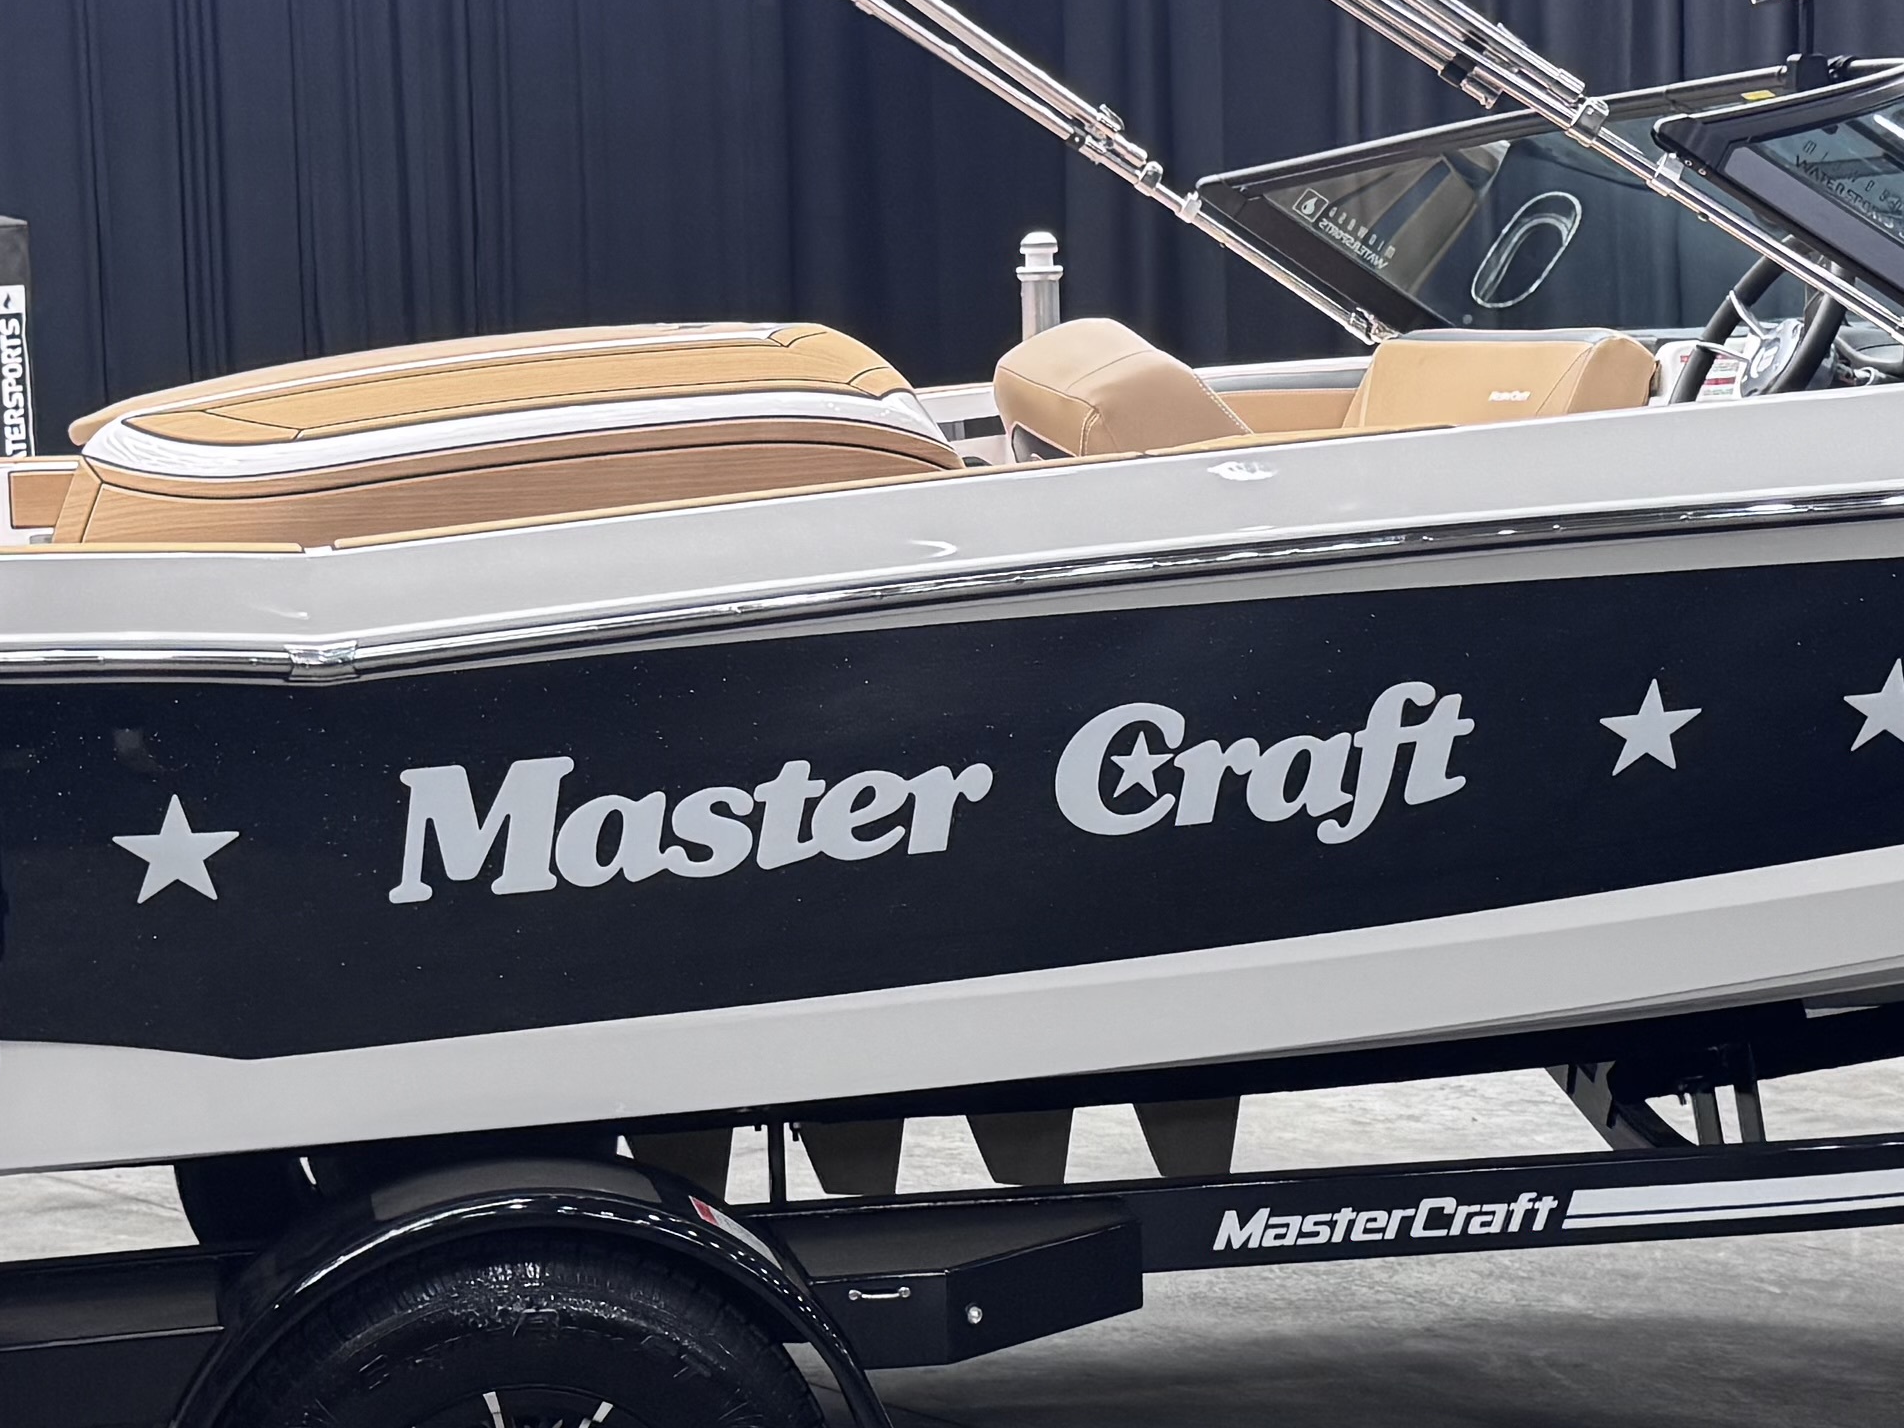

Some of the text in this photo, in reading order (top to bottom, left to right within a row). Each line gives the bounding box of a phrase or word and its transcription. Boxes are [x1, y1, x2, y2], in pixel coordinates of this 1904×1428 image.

[387, 680, 1476, 905] Master Craft
[1211, 1190, 1560, 1252] MasterCraft
